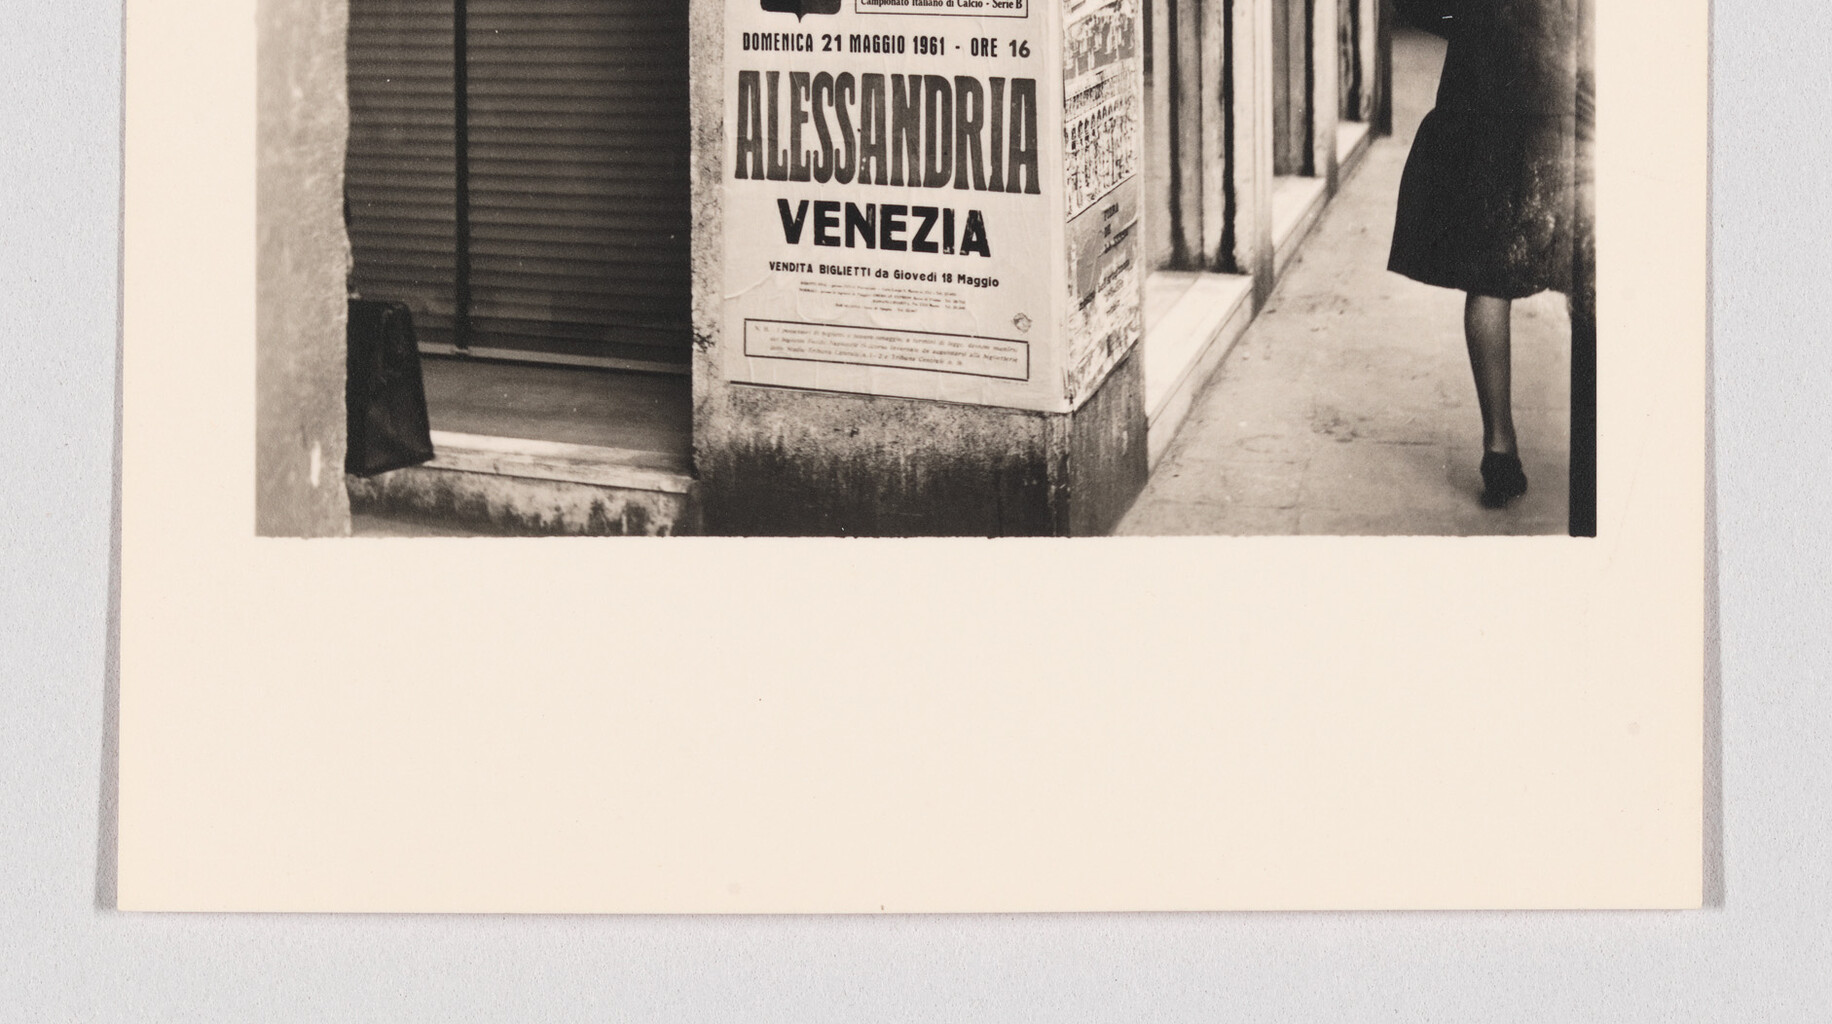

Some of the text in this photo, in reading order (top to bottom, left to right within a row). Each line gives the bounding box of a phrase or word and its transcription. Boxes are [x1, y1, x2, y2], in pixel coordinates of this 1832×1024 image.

[742, 32, 814, 53] DOMENICA
[821, 33, 843, 53] 21
[849, 34, 906, 55] MAGGIO
[913, 35, 946, 56] 1961
[970, 37, 998, 58] ORE
[1009, 39, 1031, 59] 16
[734, 70, 1041, 195] ALESSANDRIA
[776, 198, 991, 257] VENEZIA
[769, 261, 814, 273] VENDITA
[819, 264, 871, 277] BIGLIETTI
[874, 268, 889, 279] da
[941, 272, 953, 284] 18
[957, 274, 1000, 288] Maggio
